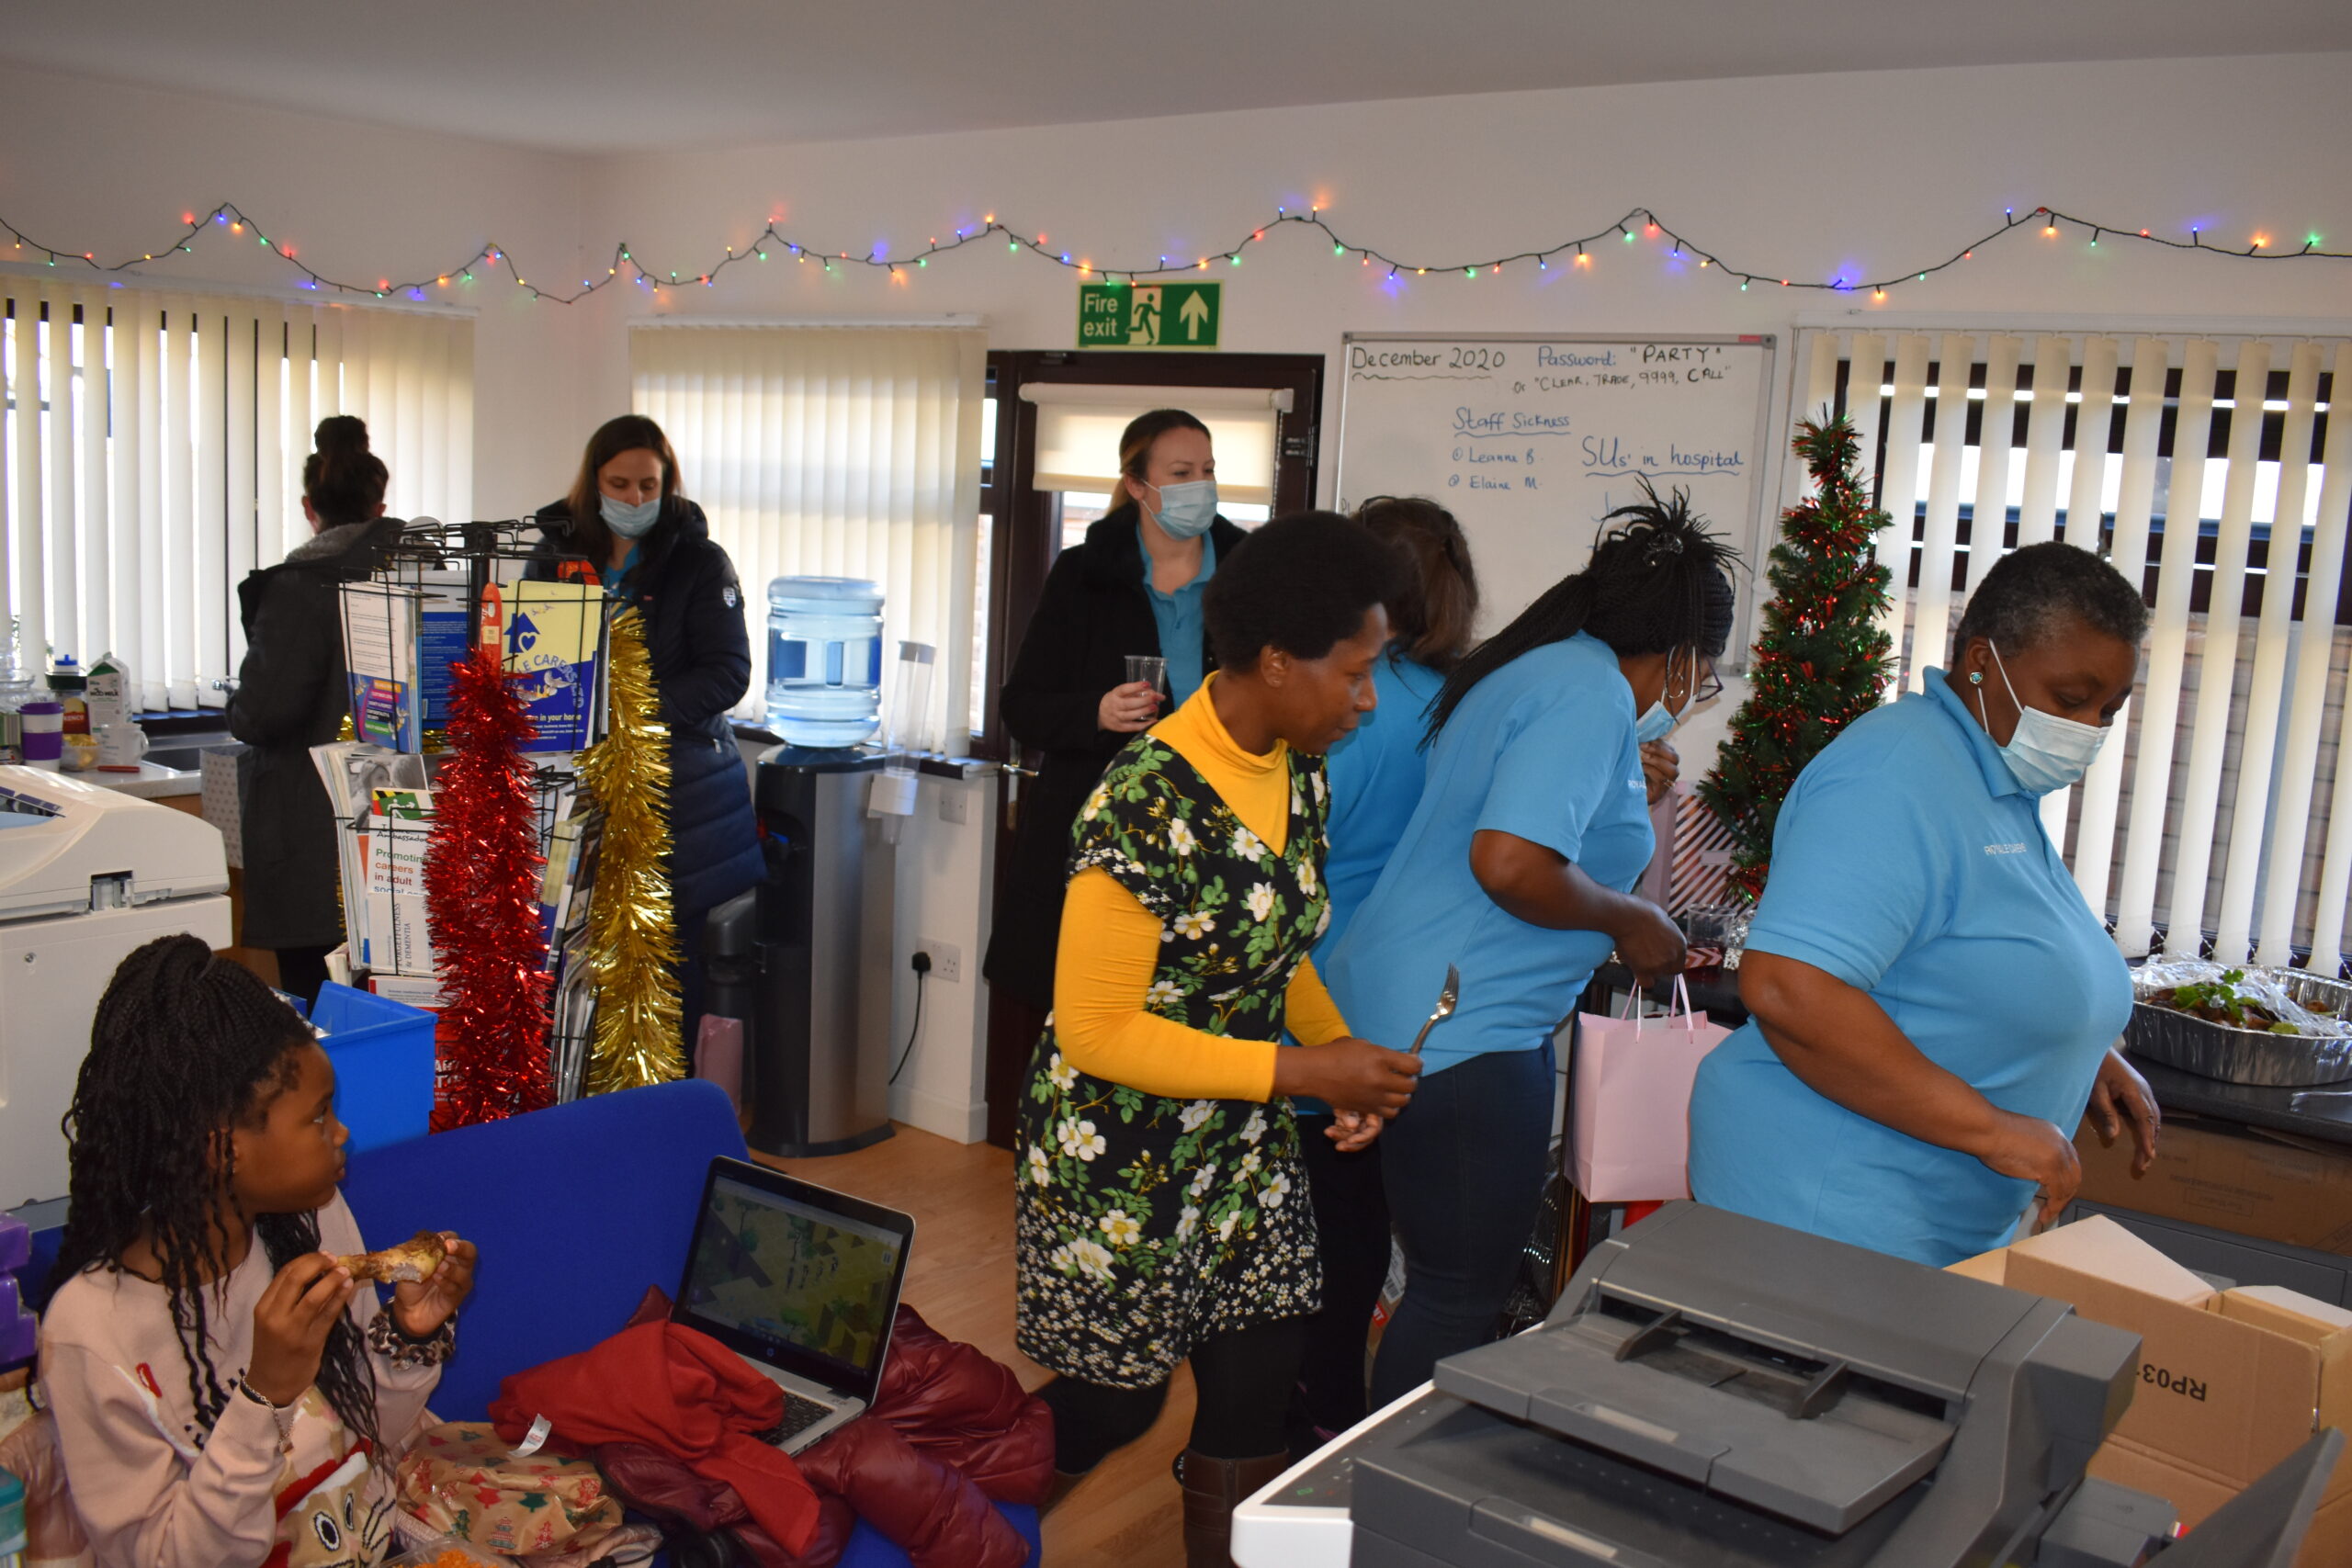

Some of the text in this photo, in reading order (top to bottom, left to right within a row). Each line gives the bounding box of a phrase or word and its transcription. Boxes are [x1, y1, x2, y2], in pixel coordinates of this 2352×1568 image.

[1084, 293, 1118, 313] Fire
[1083, 317, 1117, 337] exit
[1352, 347, 1505, 370] December 2020
[1538, 345, 1616, 367] Password:
[1453, 407, 1570, 431] Staff Sickness
[1469, 446, 1518, 463] Leanne
[1641, 446, 1659, 467] in
[1670, 444, 1745, 470] hospital
[1469, 475, 1511, 490] Elaine
[534, 654, 578, 682] CARERS
[377, 830, 428, 843] Ambassado
[376, 848, 428, 863] Promotin
[375, 862, 414, 874] careers
[375, 873, 412, 886] in adult
[374, 886, 404, 895] socal
[2137, 1364, 2207, 1403] RP03
